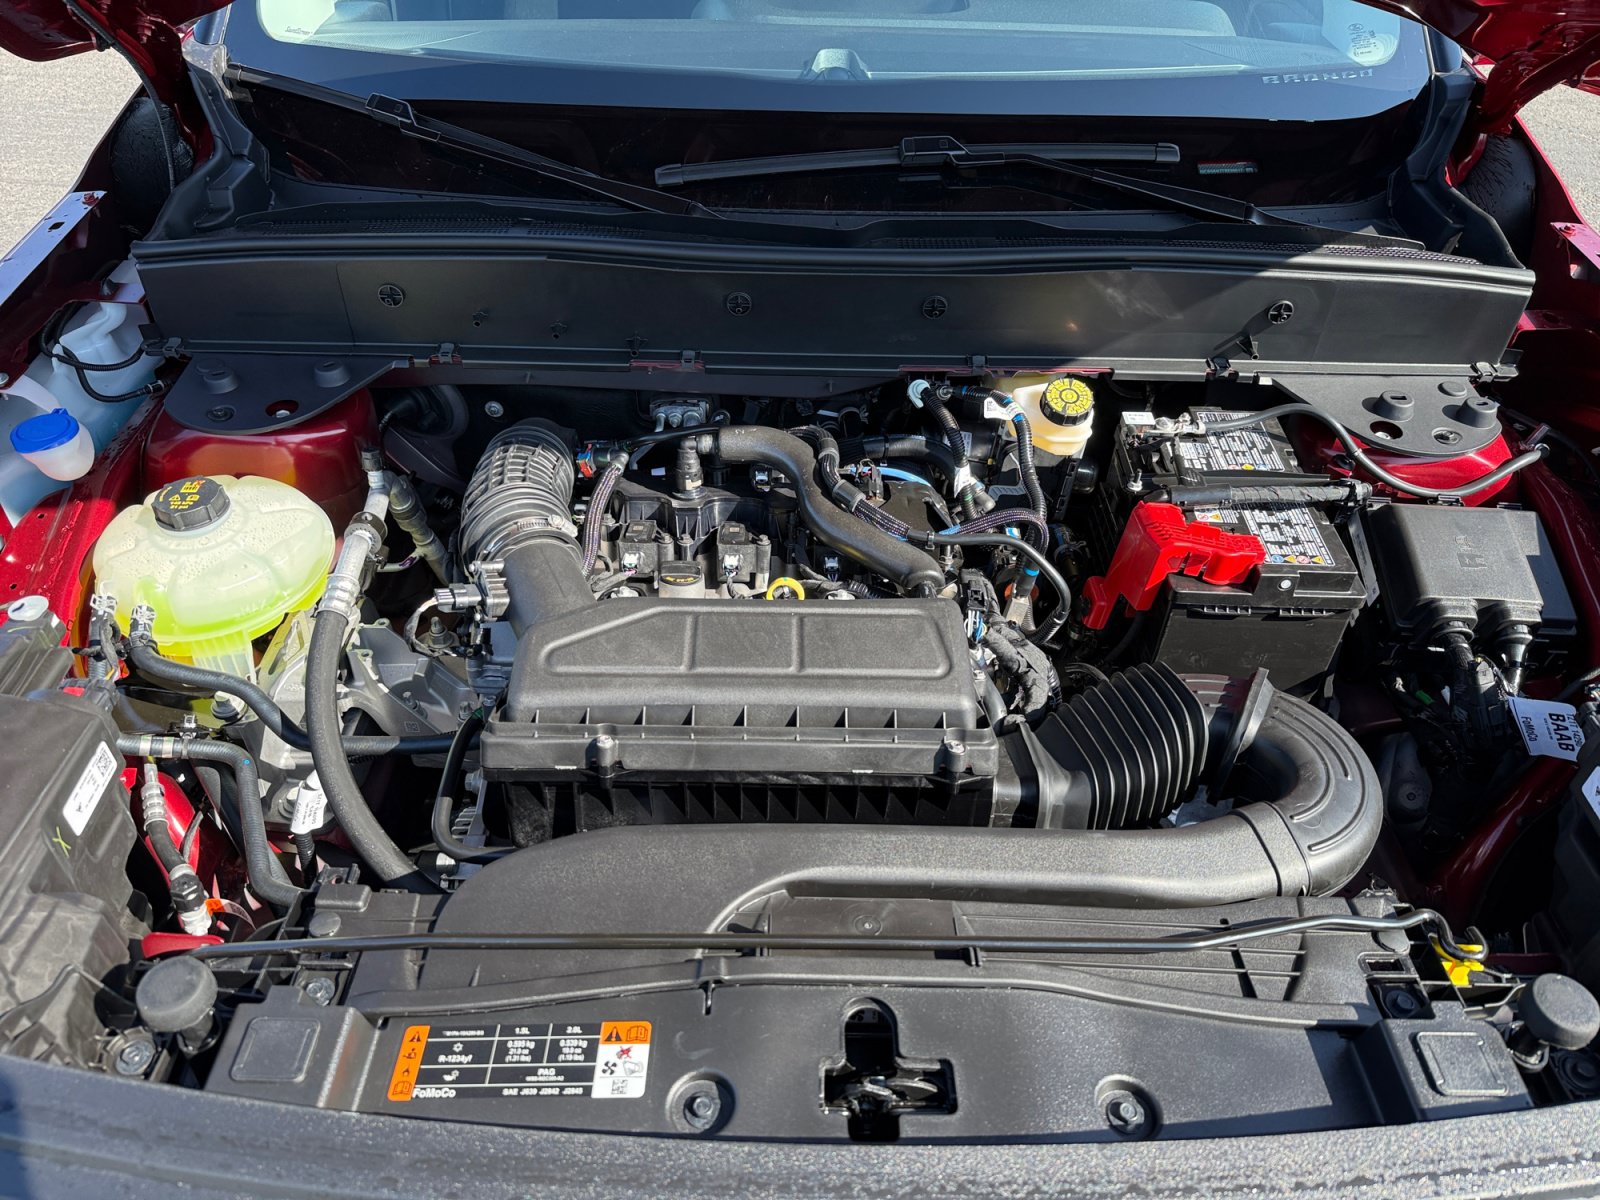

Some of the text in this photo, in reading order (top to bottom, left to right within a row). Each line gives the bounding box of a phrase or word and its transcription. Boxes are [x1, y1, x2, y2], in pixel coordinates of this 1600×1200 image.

[1261, 68, 1373, 84] BRONCO
[1521, 716, 1538, 742] FoMoCo
[1548, 713, 1575, 752] BAAB
[526, 1040, 535, 1049] kg
[578, 1039, 588, 1048] kg
[437, 1054, 473, 1064] R-1234yf
[412, 1088, 456, 1099] FoMoCo
[502, 1088, 519, 1096] SAE
